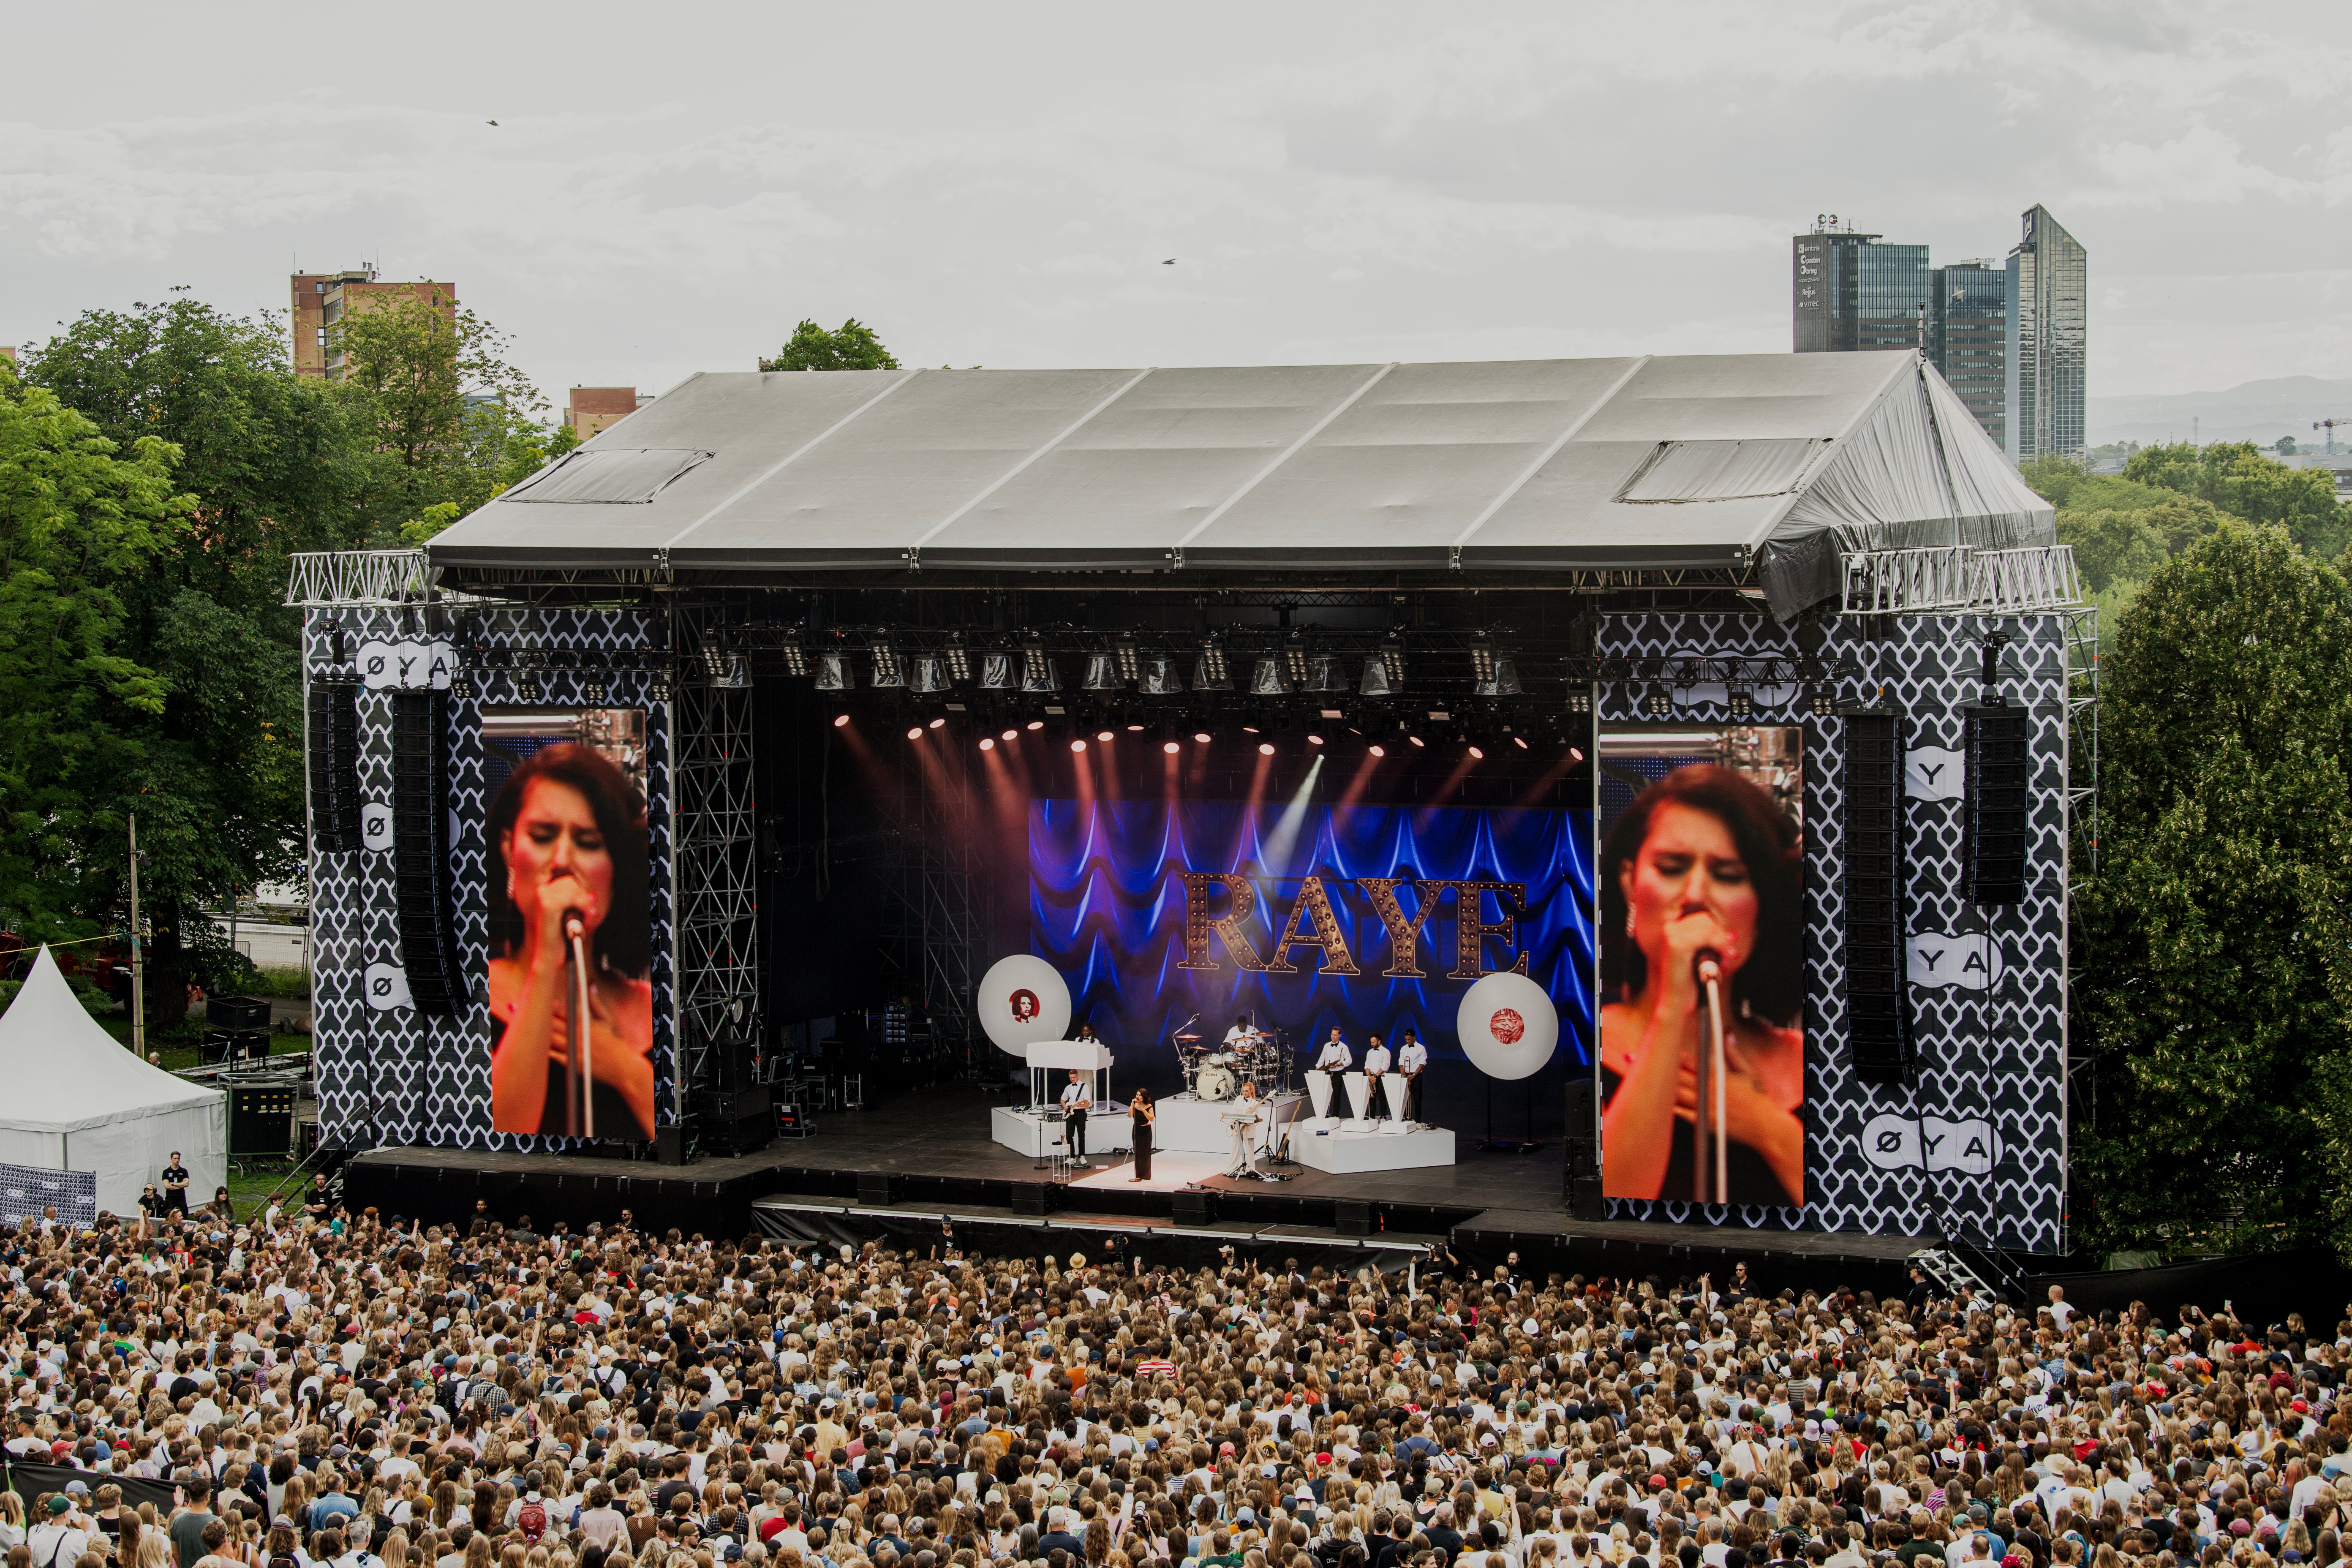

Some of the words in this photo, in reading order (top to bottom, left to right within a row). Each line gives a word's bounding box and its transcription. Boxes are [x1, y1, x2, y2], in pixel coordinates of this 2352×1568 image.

[1802, 289, 1816, 298] Regus
[367, 656, 448, 675] ØYA
[1176, 872, 1528, 979] RAYE
[1876, 1131, 1988, 1158] ØYA
